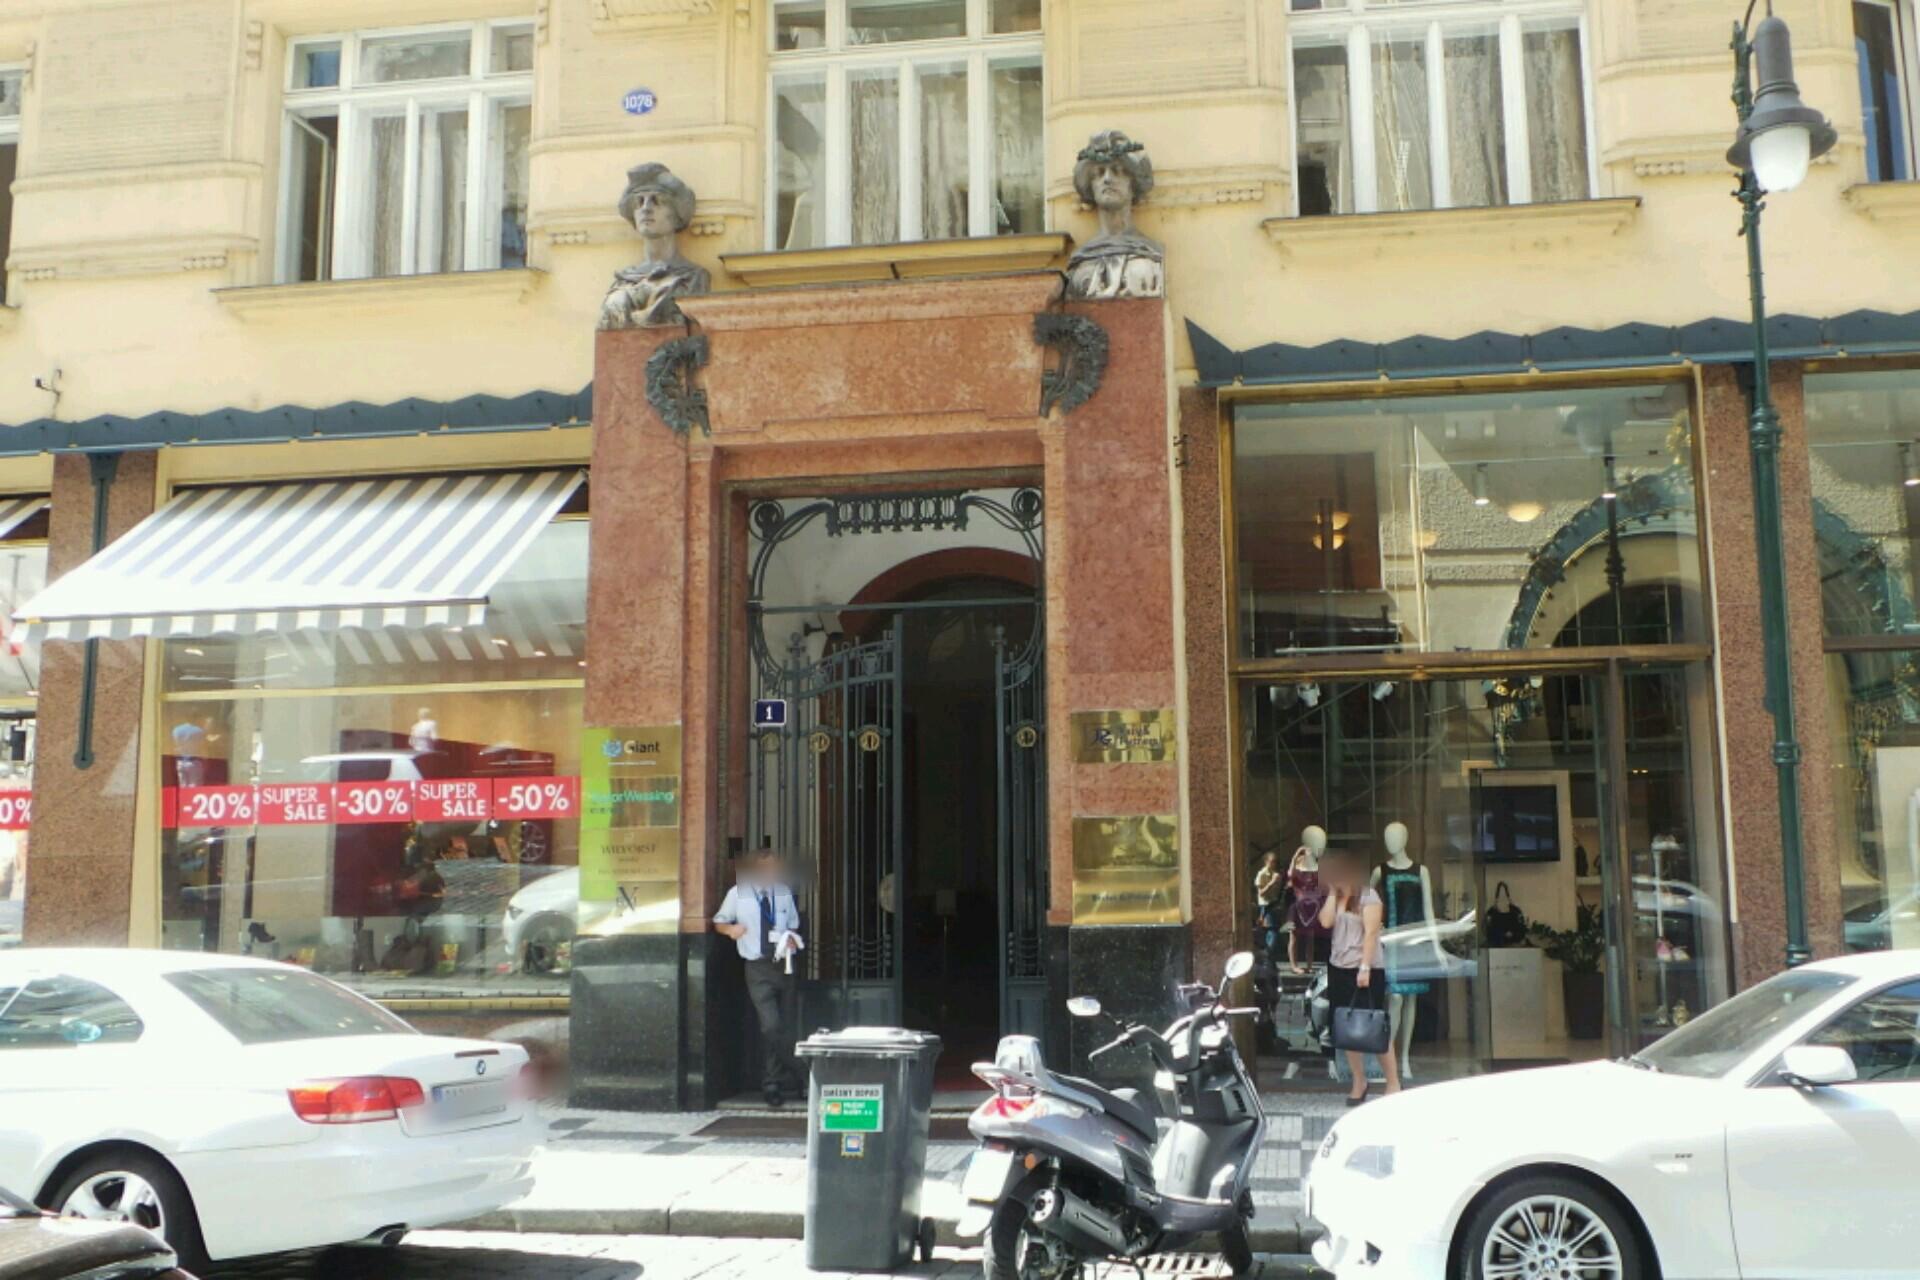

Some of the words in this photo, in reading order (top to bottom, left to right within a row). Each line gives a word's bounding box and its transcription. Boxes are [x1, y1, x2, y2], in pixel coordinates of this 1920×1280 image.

[624, 94, 653, 112] 1078
[765, 704, 774, 720] 1
[623, 739, 661, 755] Giant
[262, 787, 318, 804] SUPER
[419, 781, 478, 800] SUPER
[498, 783, 570, 812] -50%
[183, 792, 251, 820] -20%
[338, 788, 408, 816] -30%
[441, 799, 487, 817] SALE
[283, 803, 328, 821] SALE
